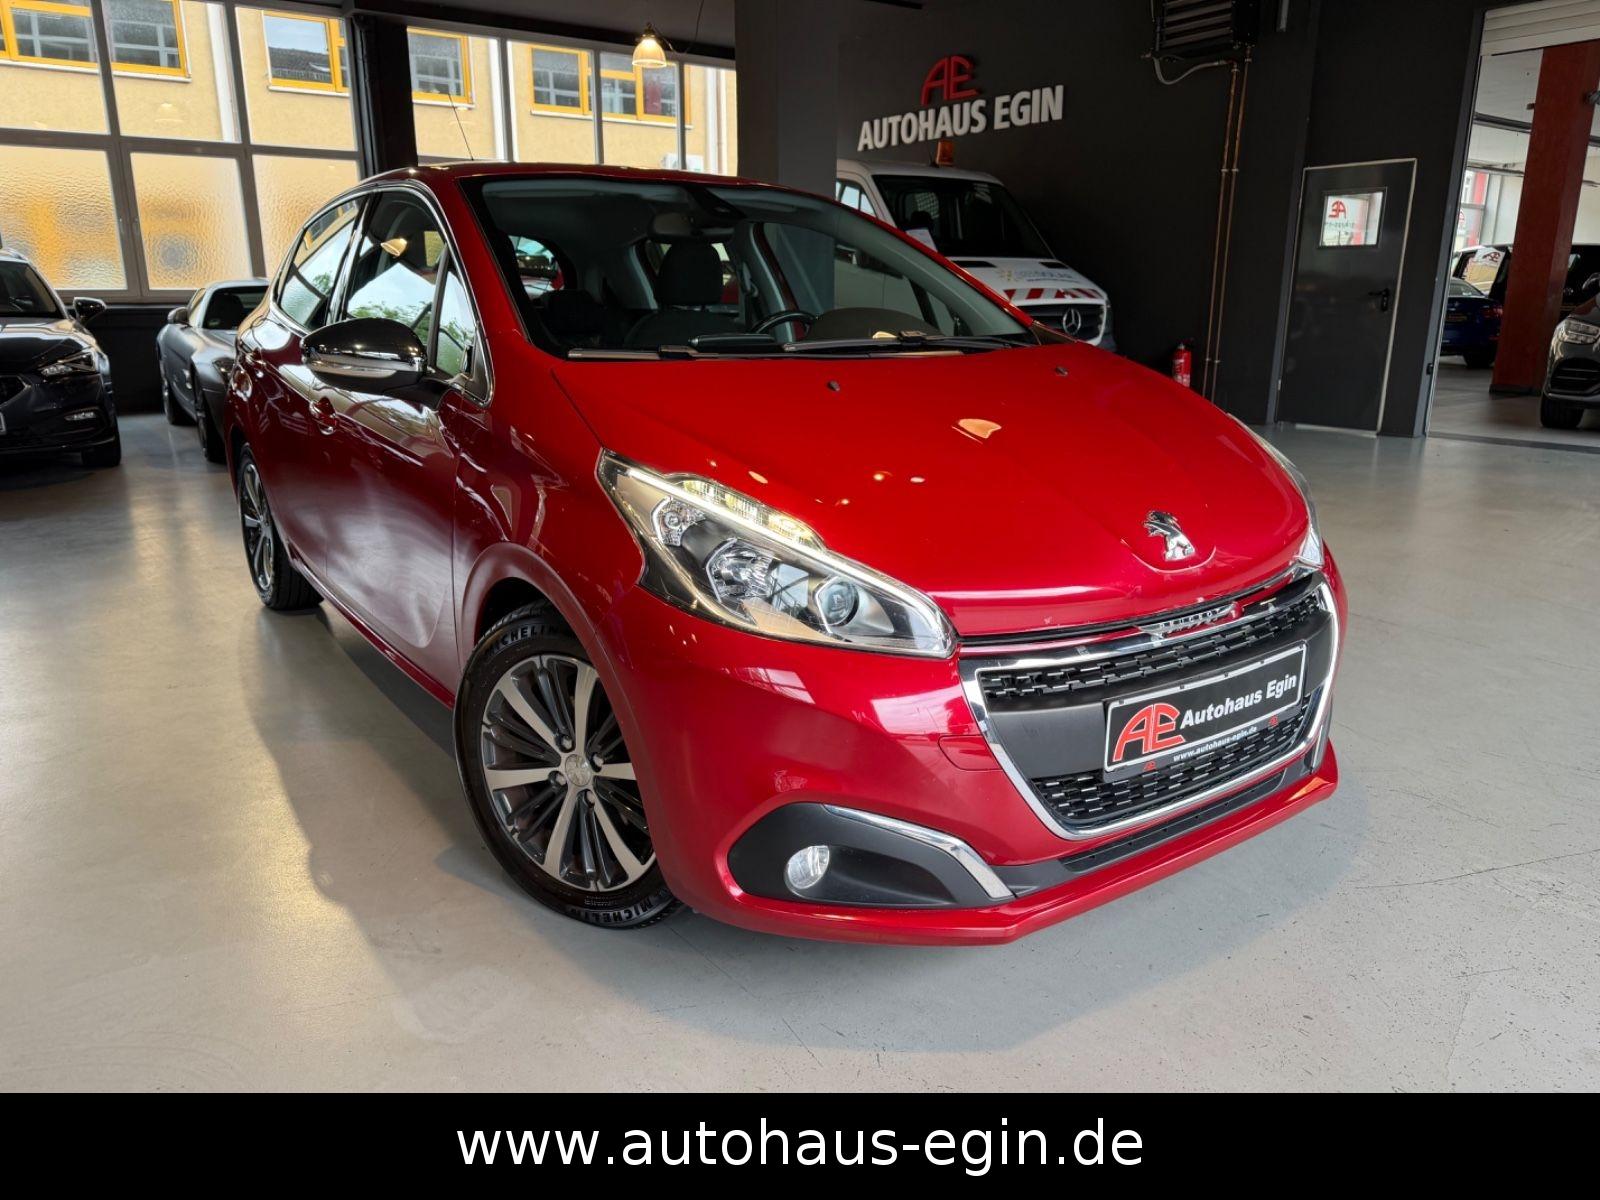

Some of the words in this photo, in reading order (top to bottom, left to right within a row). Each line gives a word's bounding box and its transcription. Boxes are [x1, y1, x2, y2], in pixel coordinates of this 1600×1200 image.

[857, 99, 988, 152] AUTOHAUS
[993, 84, 1064, 130] EGIN
[1180, 689, 1263, 730] Autohaus
[1266, 673, 1297, 699] Egin
[1112, 702, 1186, 763] AE
